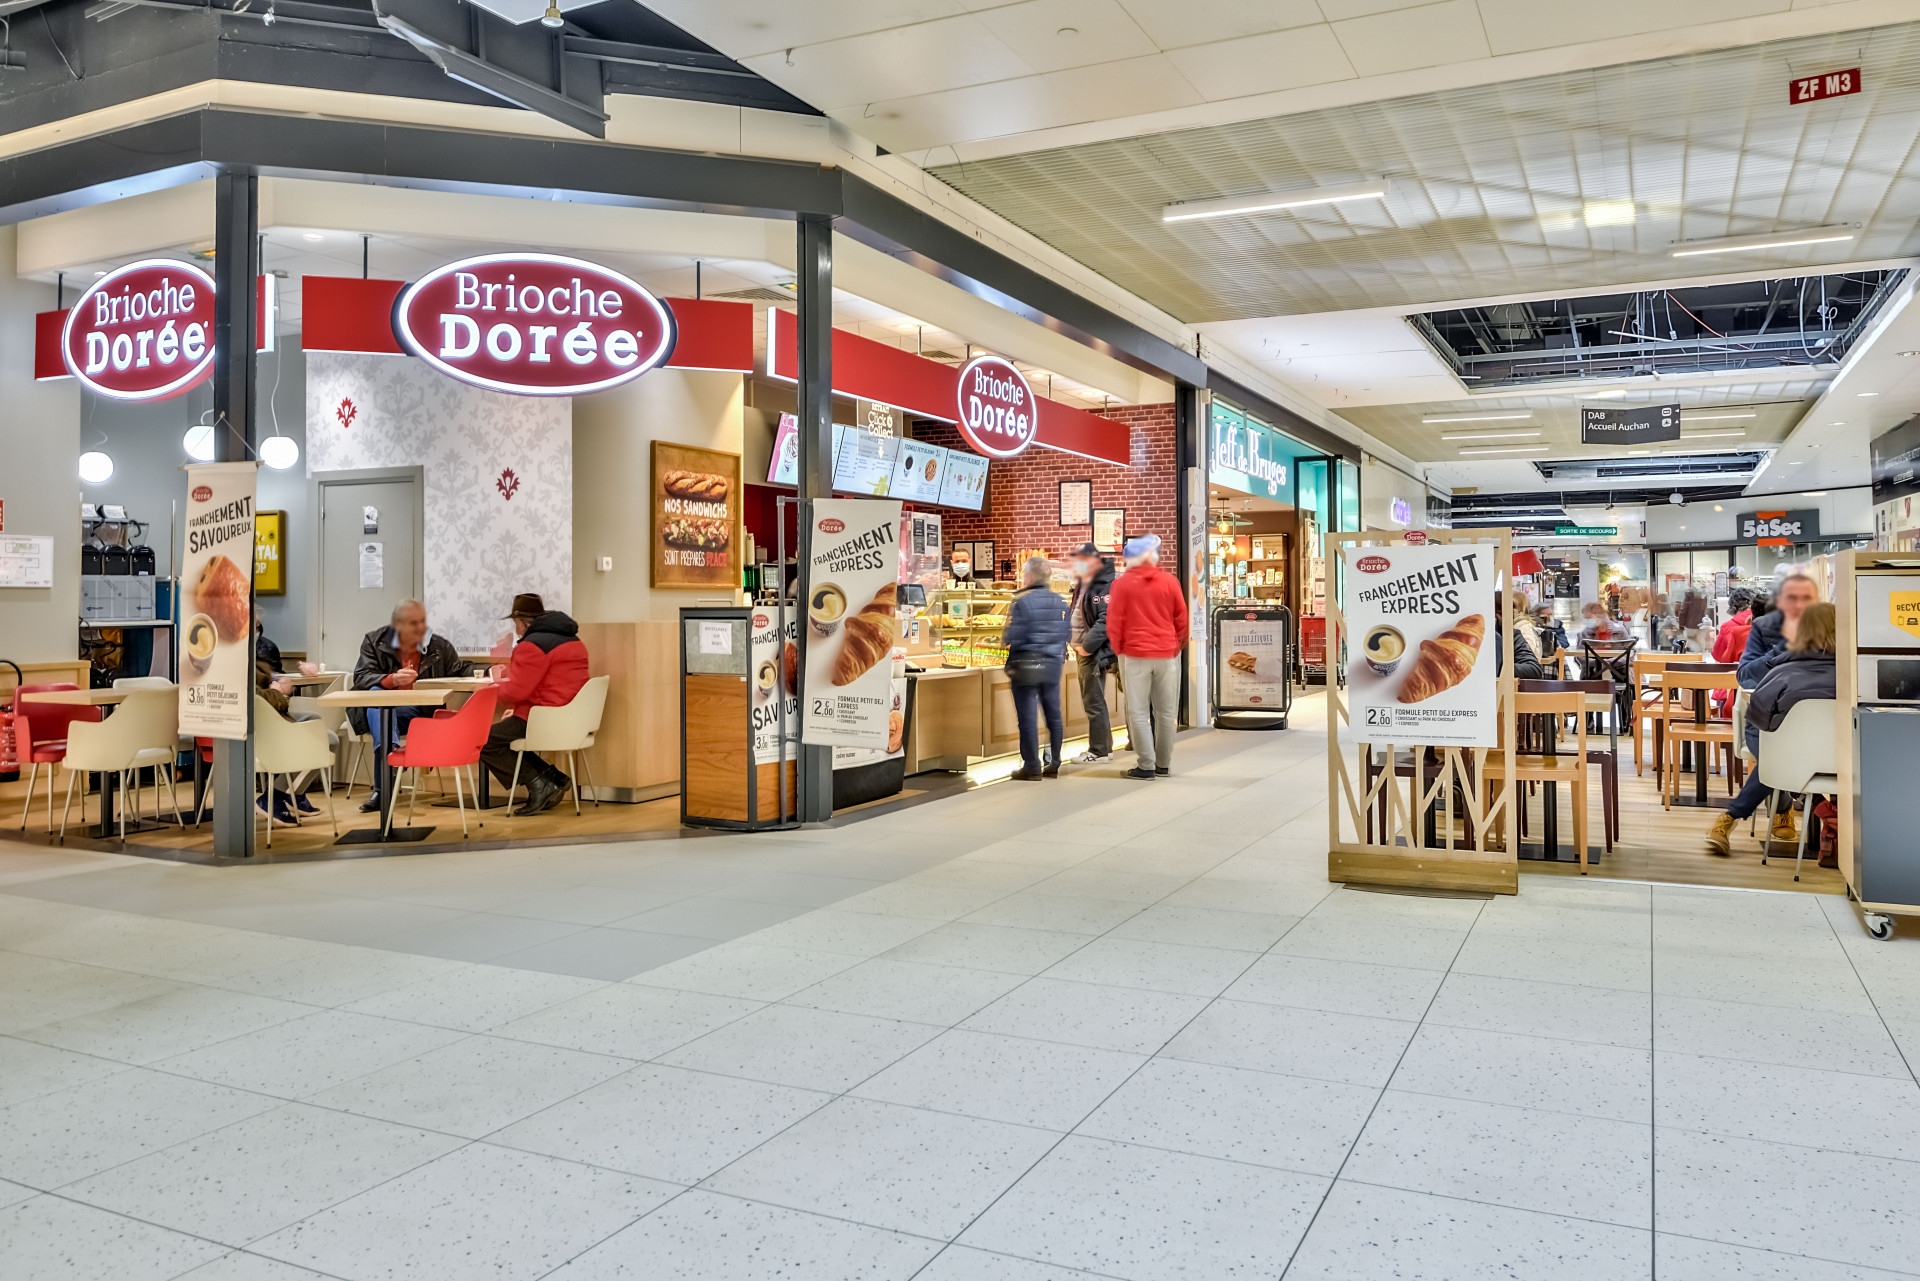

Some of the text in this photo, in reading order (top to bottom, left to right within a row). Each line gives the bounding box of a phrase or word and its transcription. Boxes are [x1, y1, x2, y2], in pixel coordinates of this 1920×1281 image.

[1798, 73, 1852, 101] ZF M3
[94, 277, 197, 327] Brioche
[454, 272, 623, 319] Brioche
[85, 319, 207, 375] Dorée
[439, 313, 640, 368] Dorée
[974, 366, 1024, 406] Brioche
[969, 395, 1028, 440] Dorée
[1588, 411, 1605, 420] DAB
[1588, 422, 1650, 432] Accueil Auchan
[868, 423, 894, 440] Collect
[1209, 422, 1287, 496] Jeff de Bruges
[189, 496, 252, 528] FRANCHEMENT
[664, 499, 728, 518] NOS SANDWICHS
[189, 521, 252, 554] SAVOUREUX
[813, 521, 894, 566] FRANCHEMENT
[664, 549, 679, 566] SONT
[830, 550, 884, 573] EXPRESS
[1360, 561, 1388, 571] Dorée
[1358, 553, 1479, 603] FRANCHEMENT
[1381, 589, 1461, 615] EXPRESS
[206, 691, 217, 699] PETIT
[207, 683, 225, 691] FORMULE
[837, 695, 860, 704] FORMULE
[860, 697, 873, 705] PETIT
[837, 702, 859, 710] EXPRESS
[1395, 708, 1478, 718] FORMULE PETIT DEJ EXPRESS
